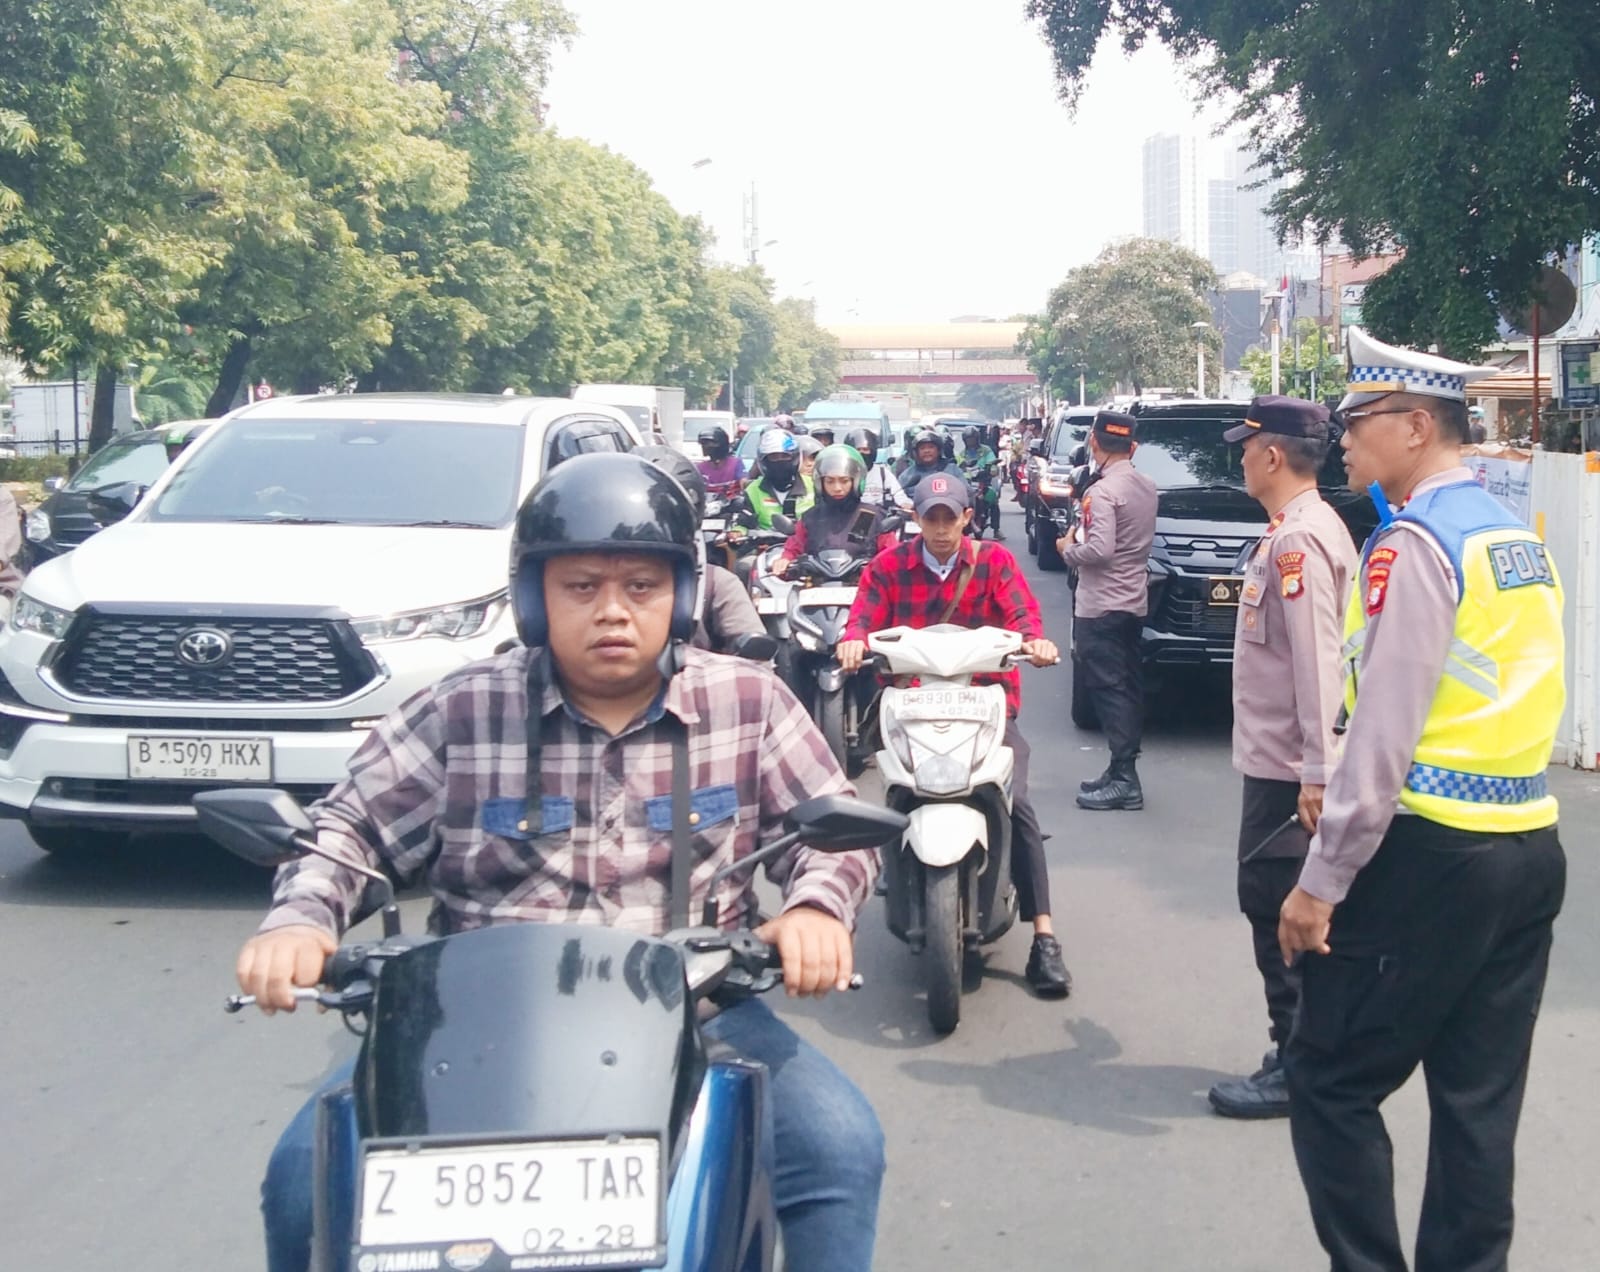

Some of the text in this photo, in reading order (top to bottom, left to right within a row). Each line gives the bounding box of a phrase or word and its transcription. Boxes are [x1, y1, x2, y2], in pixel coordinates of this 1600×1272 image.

[139, 742, 151, 763] B
[221, 743, 261, 765] HKX
[375, 1156, 645, 1215] Z 5852 TAR
[377, 1250, 439, 1272] YAMAHA
